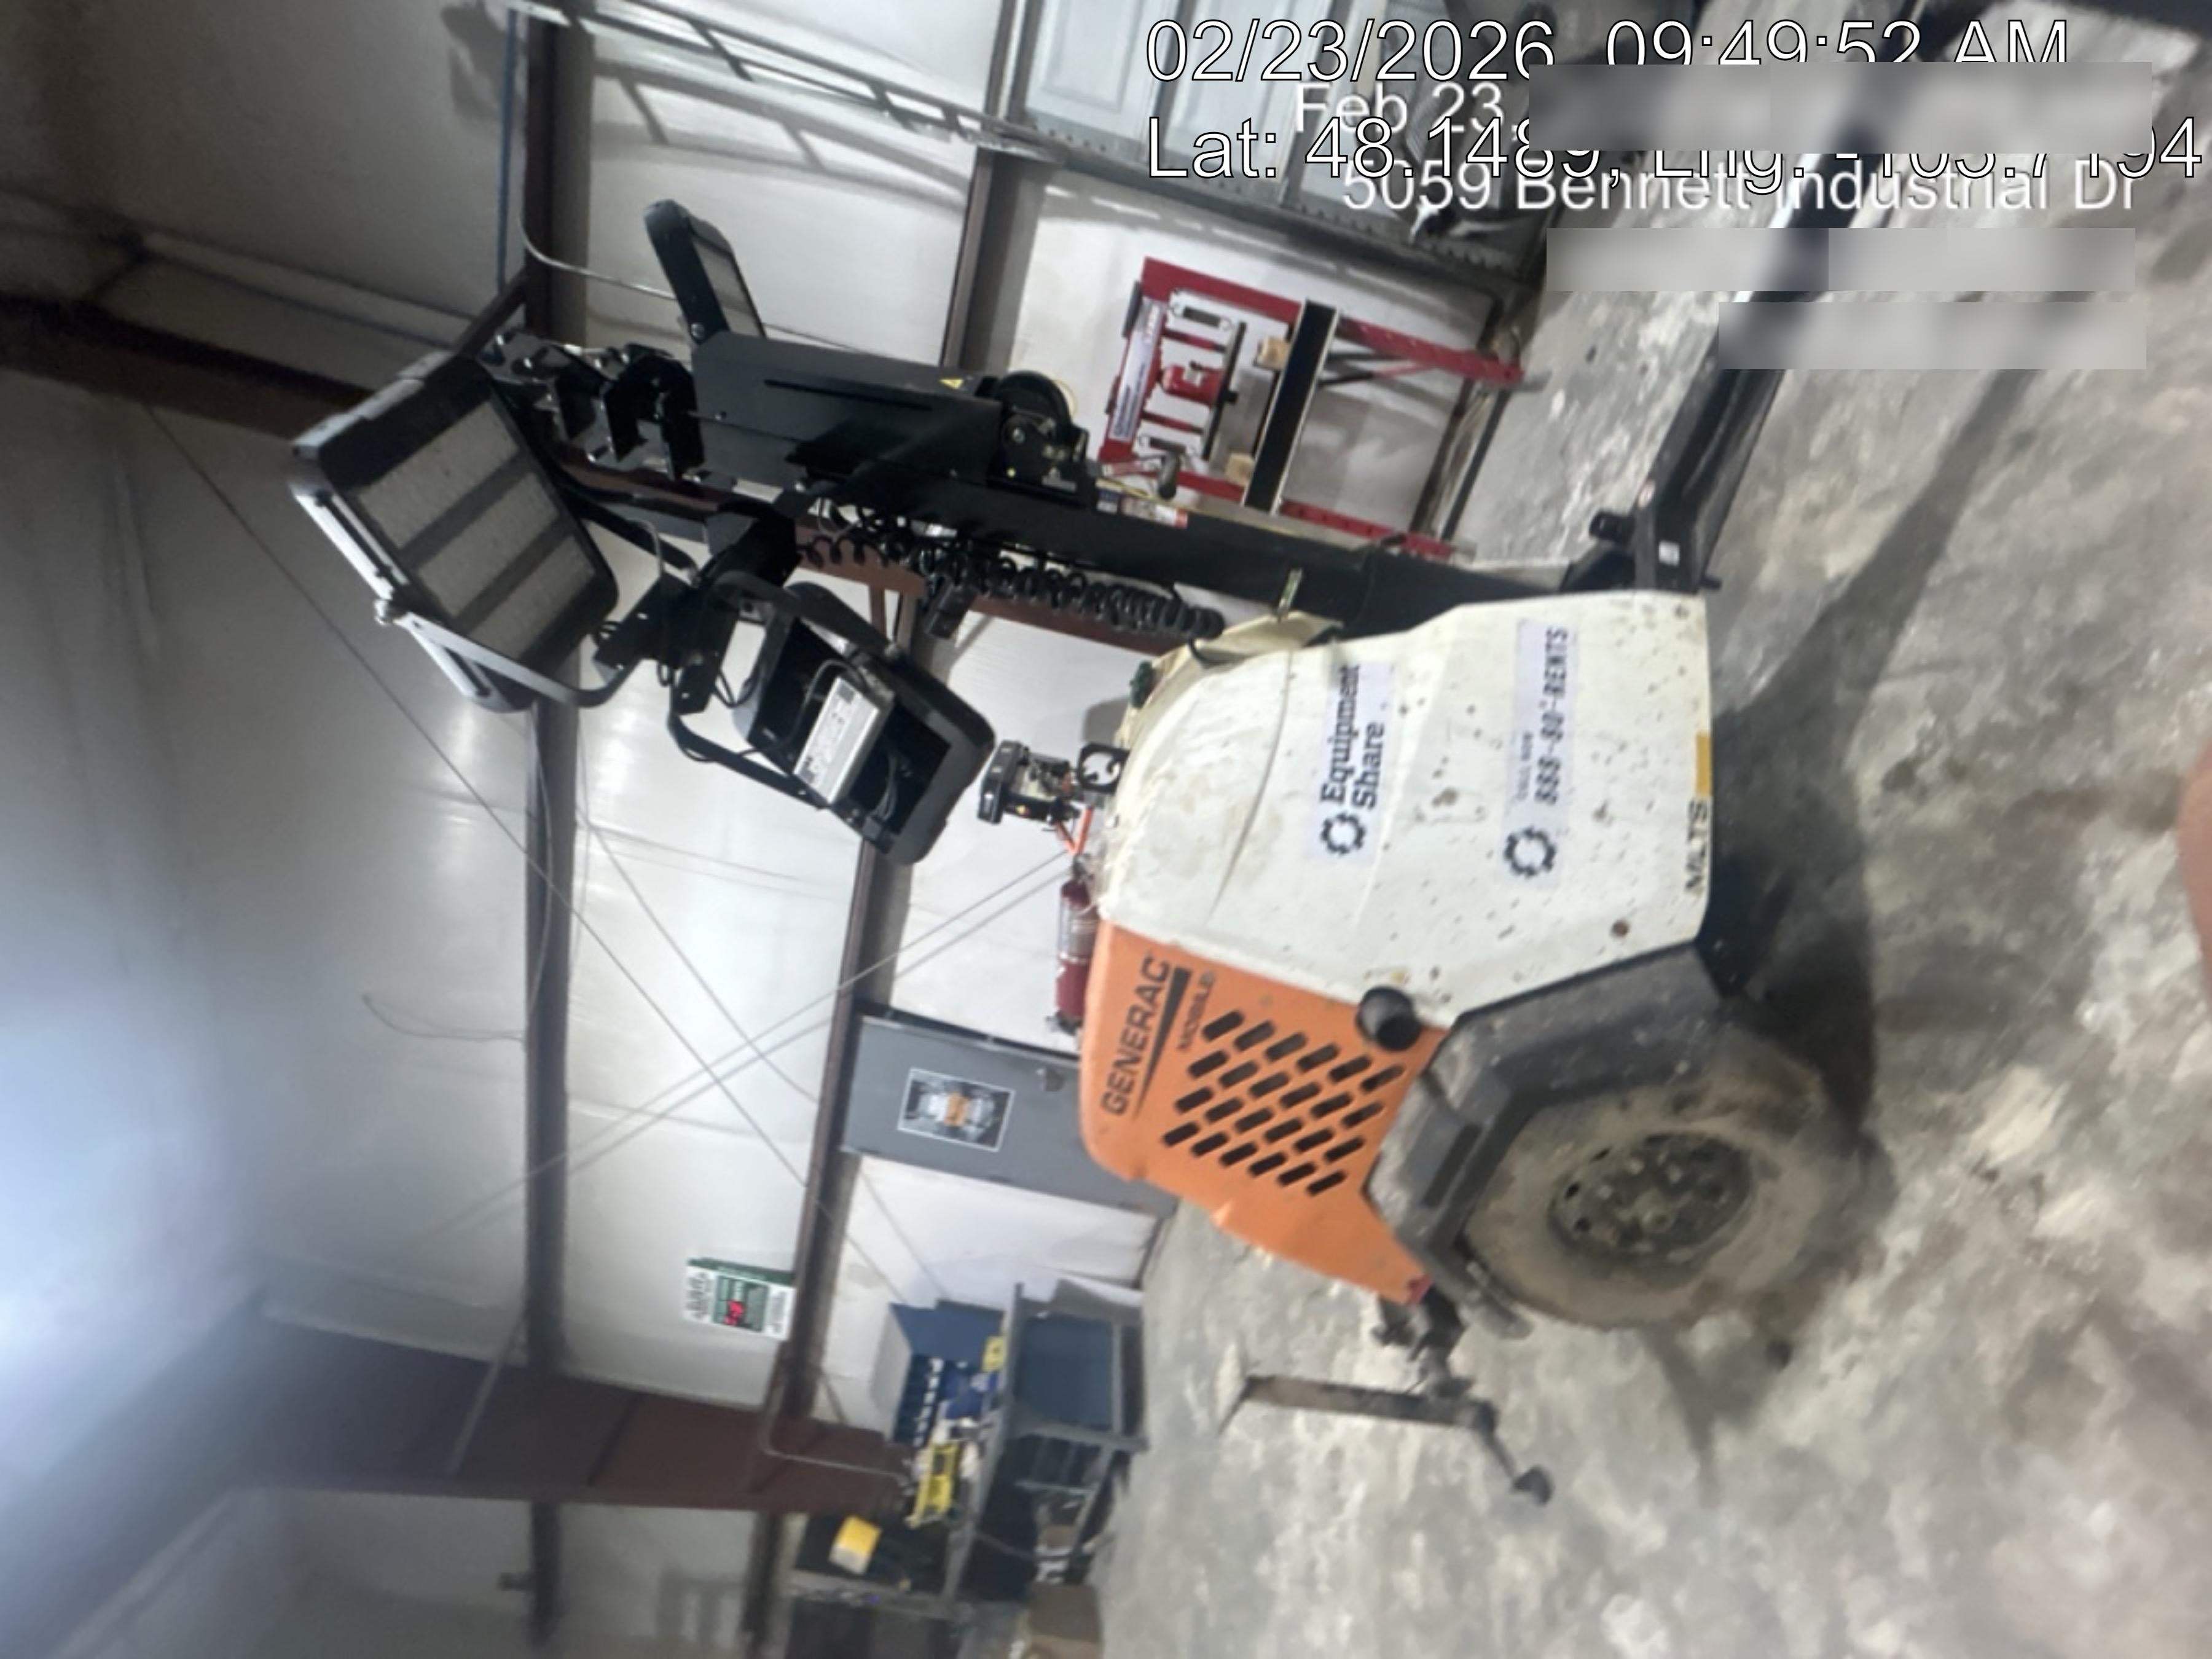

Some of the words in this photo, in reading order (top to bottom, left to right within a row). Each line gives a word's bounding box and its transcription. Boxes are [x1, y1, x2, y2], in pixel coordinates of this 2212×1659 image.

[1319, 665, 1359, 805] Equipment
[1351, 723, 1384, 810] Share
[1100, 956, 1169, 1116] GENERAC
